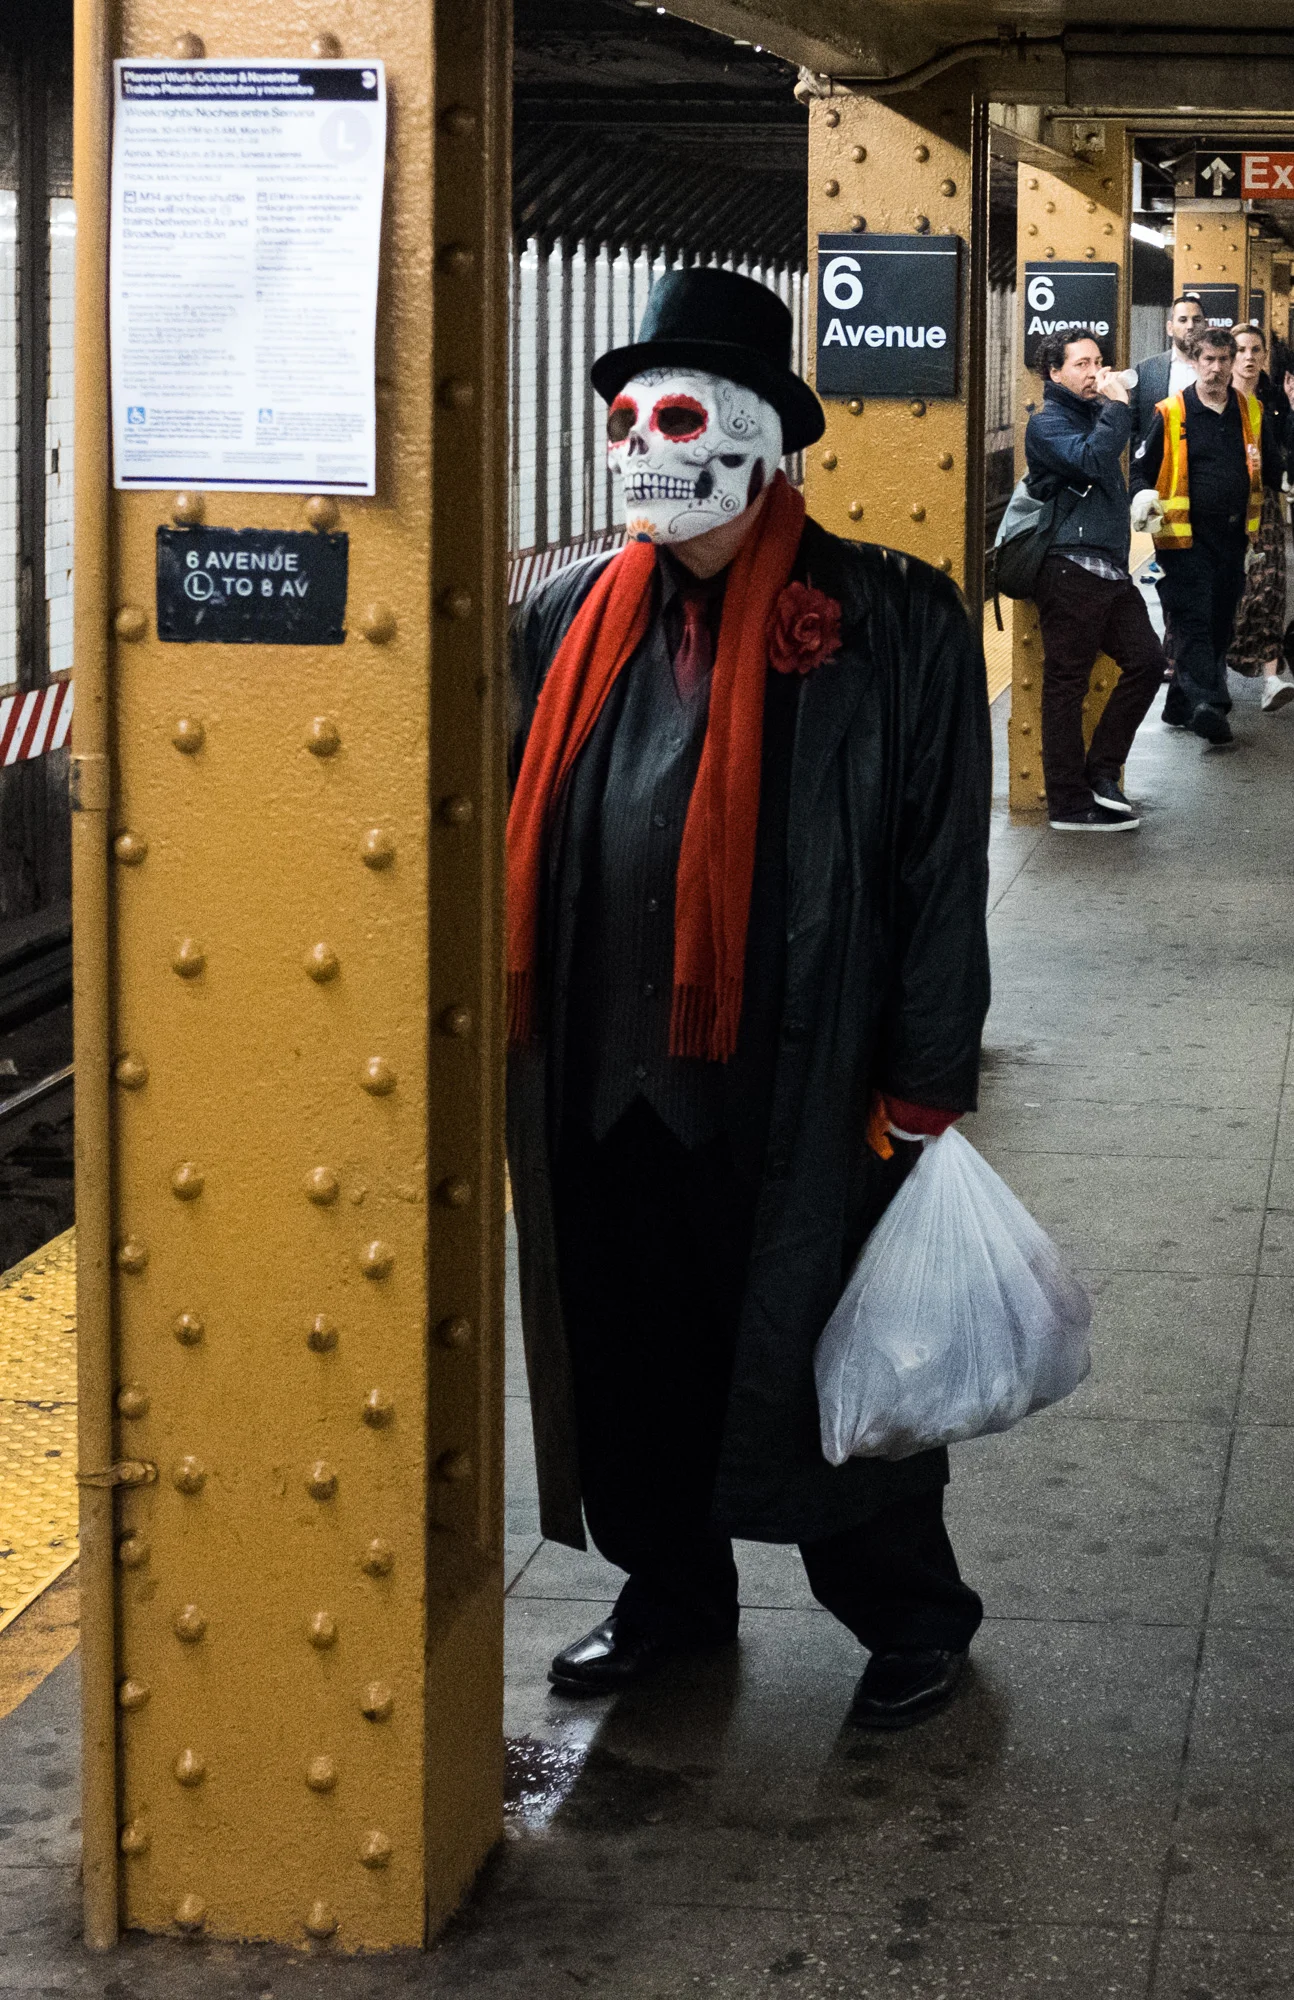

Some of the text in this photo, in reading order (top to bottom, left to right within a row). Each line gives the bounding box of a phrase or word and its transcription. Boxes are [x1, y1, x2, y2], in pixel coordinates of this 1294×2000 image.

[823, 256, 863, 310] 6
[1027, 276, 1055, 312] 6
[822, 318, 947, 349] Avenue
[1206, 315, 1233, 328] nue
[186, 551, 299, 571] 6 AVENUE
[222, 578, 253, 597] TO
[261, 578, 273, 597] 8
[280, 579, 309, 597] AV
